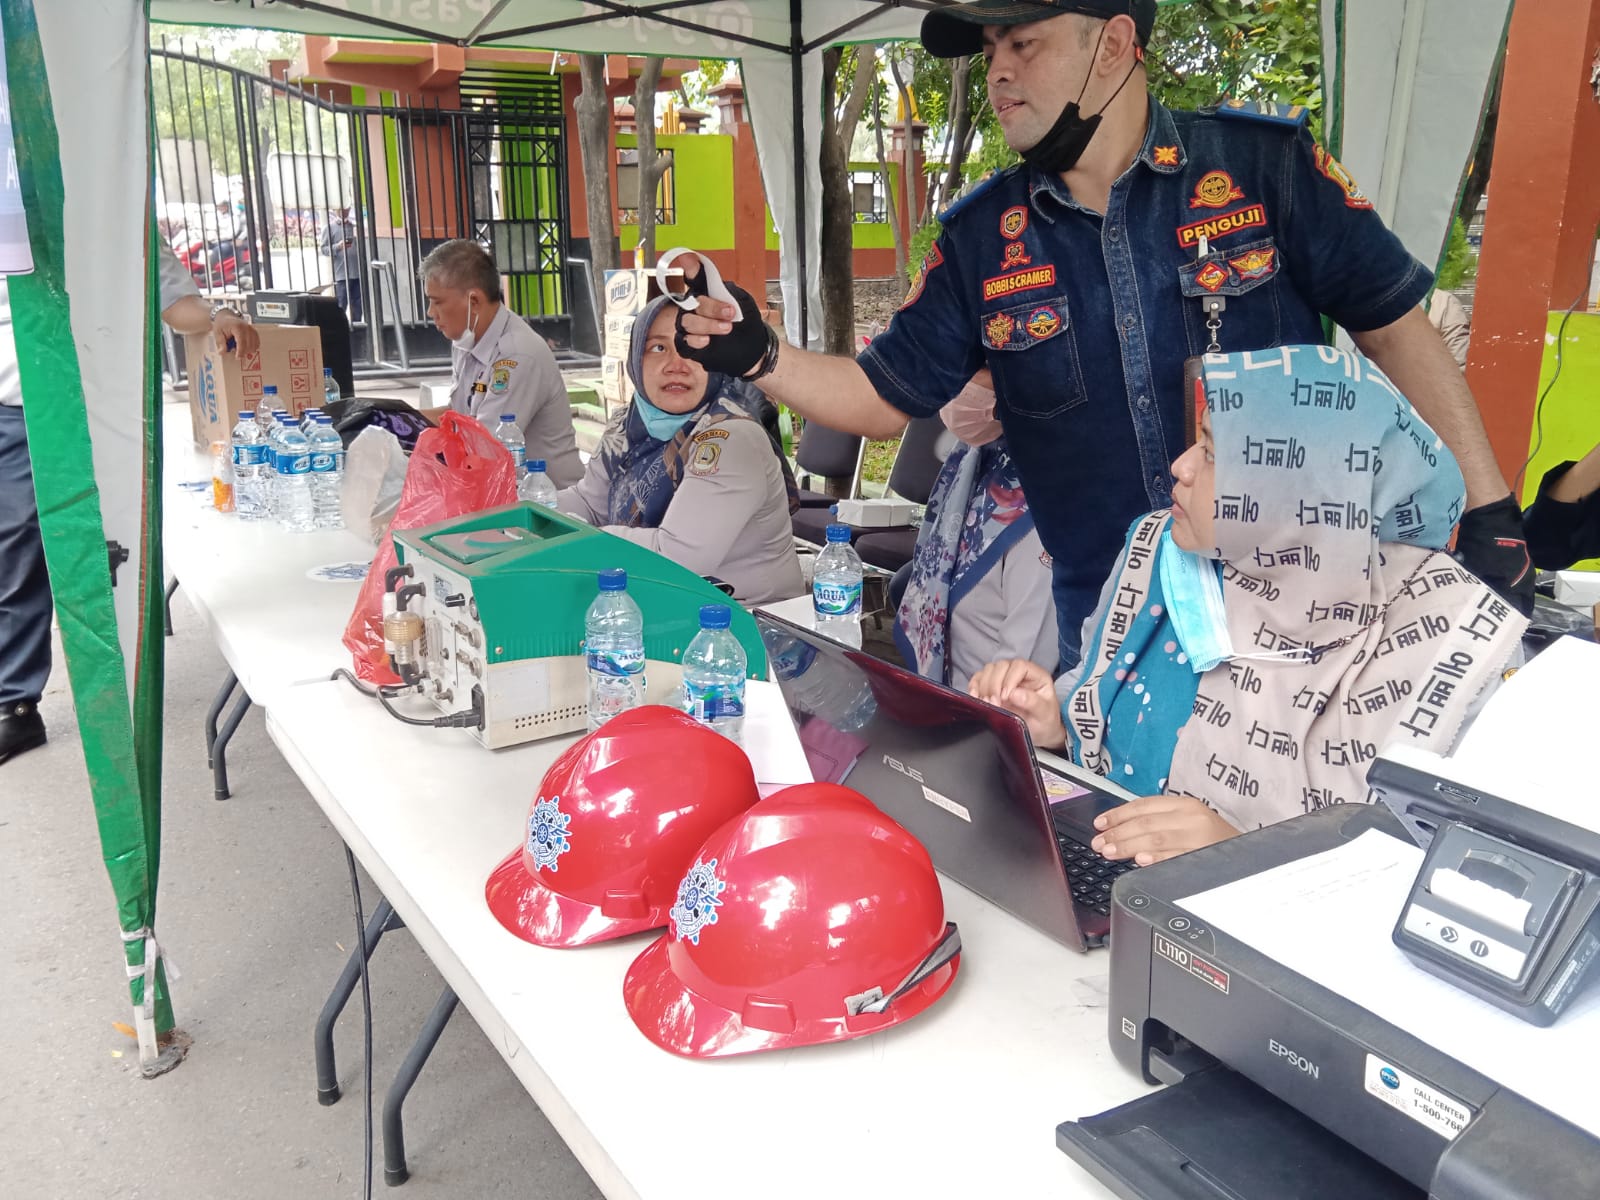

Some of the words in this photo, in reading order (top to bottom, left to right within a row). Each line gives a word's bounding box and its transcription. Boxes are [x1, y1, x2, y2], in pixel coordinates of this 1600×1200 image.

[1183, 208, 1260, 242] PENGUJI
[817, 588, 846, 603] AQUA
[882, 754, 925, 784] ASUS
[1159, 939, 1187, 965] L1110
[1269, 1038, 1320, 1079] EPSON
[1414, 1087, 1433, 1104] CALL
[1434, 1099, 1465, 1122] CENTER
